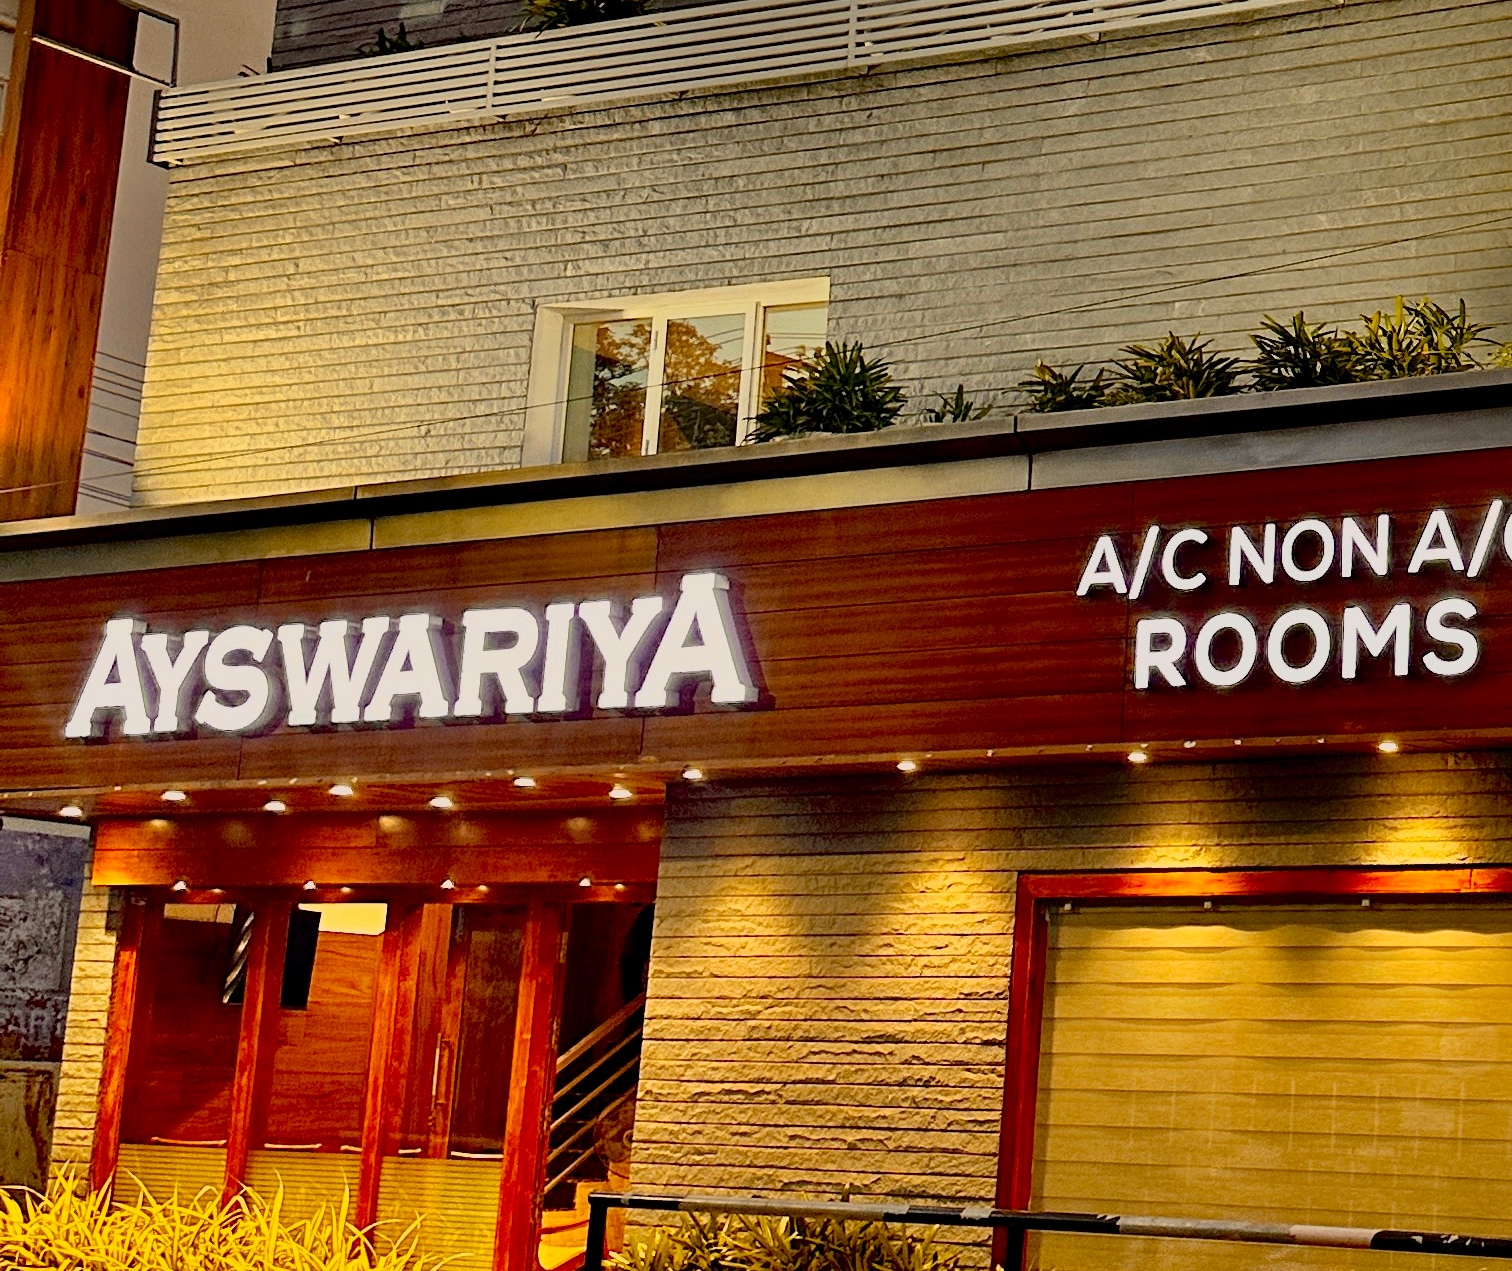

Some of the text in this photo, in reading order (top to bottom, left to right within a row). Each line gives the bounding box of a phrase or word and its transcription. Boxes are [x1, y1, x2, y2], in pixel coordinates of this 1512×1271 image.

[1077, 526, 1207, 599] A/C
[1229, 514, 1390, 586] NON
[65, 573, 757, 738] AYSWARIYA
[1134, 598, 1479, 689] ROOMS
